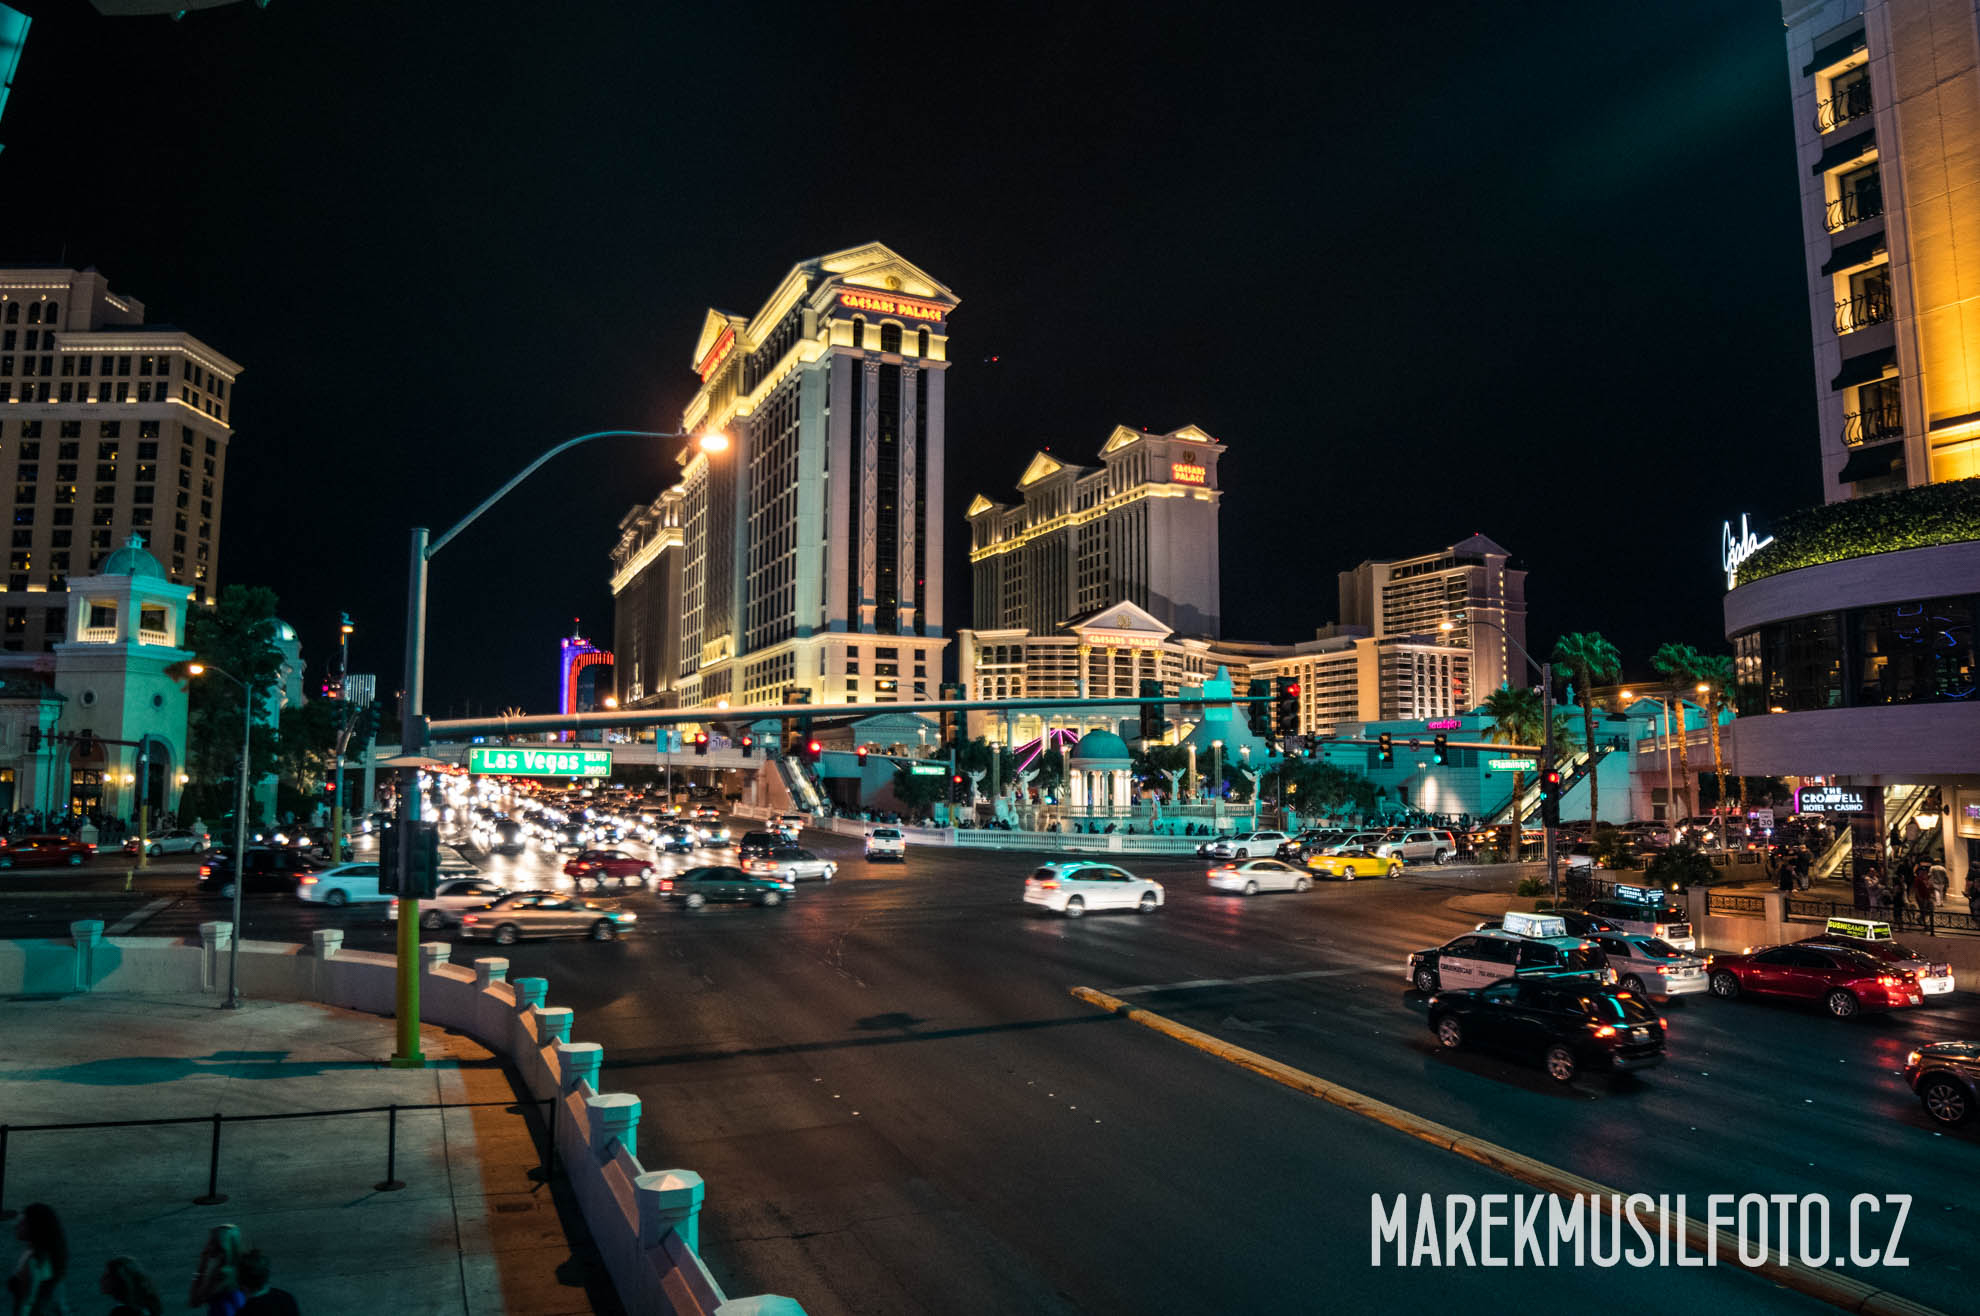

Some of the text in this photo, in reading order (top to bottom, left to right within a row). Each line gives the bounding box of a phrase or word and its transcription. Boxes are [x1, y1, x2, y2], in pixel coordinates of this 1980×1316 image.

[840, 294, 942, 322] CAESARS PALACE
[1170, 463, 1206, 475] CAESARS
[1170, 472, 1205, 483] PALACE
[483, 750, 518, 769] Las
[523, 751, 579, 774] Vegas
[1802, 793, 1864, 803] CROMWELL
